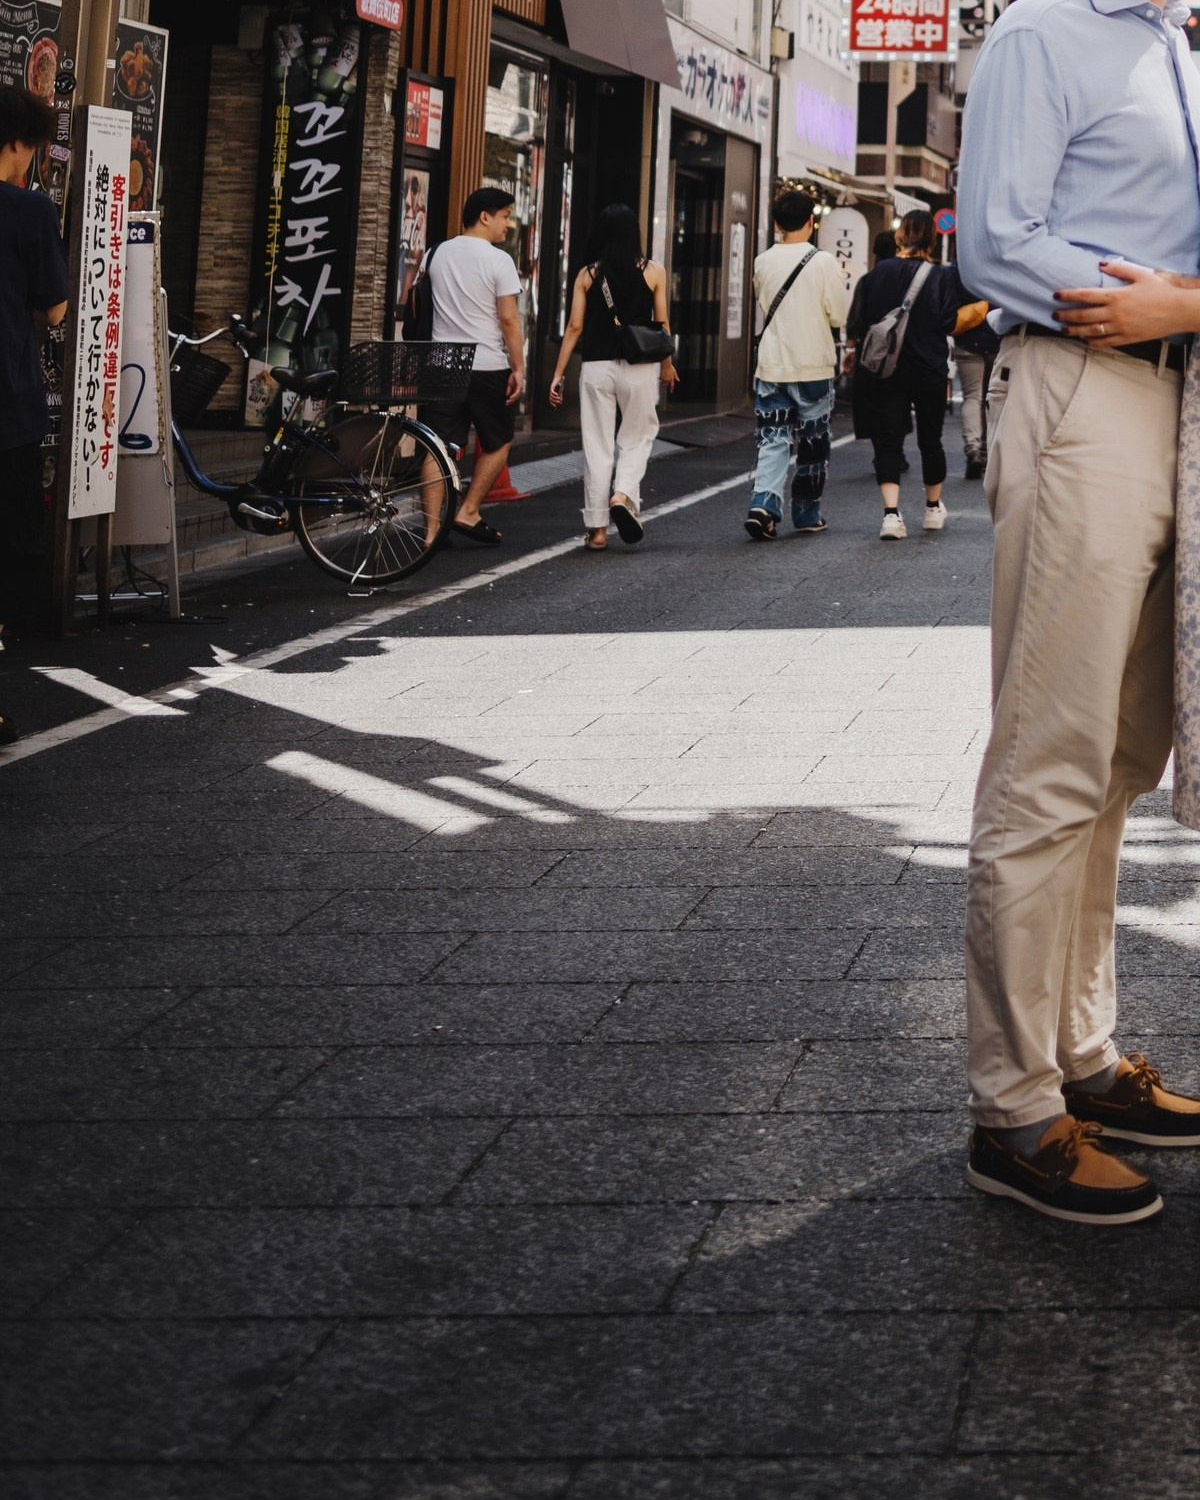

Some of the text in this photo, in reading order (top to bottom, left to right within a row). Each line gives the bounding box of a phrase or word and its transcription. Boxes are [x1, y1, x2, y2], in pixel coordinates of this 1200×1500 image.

[855, 18, 944, 48] 営業中
[57, 113, 71, 141] DOVES
[274, 100, 348, 337] 꼬꼬포차
[126, 226, 146, 241] ce
